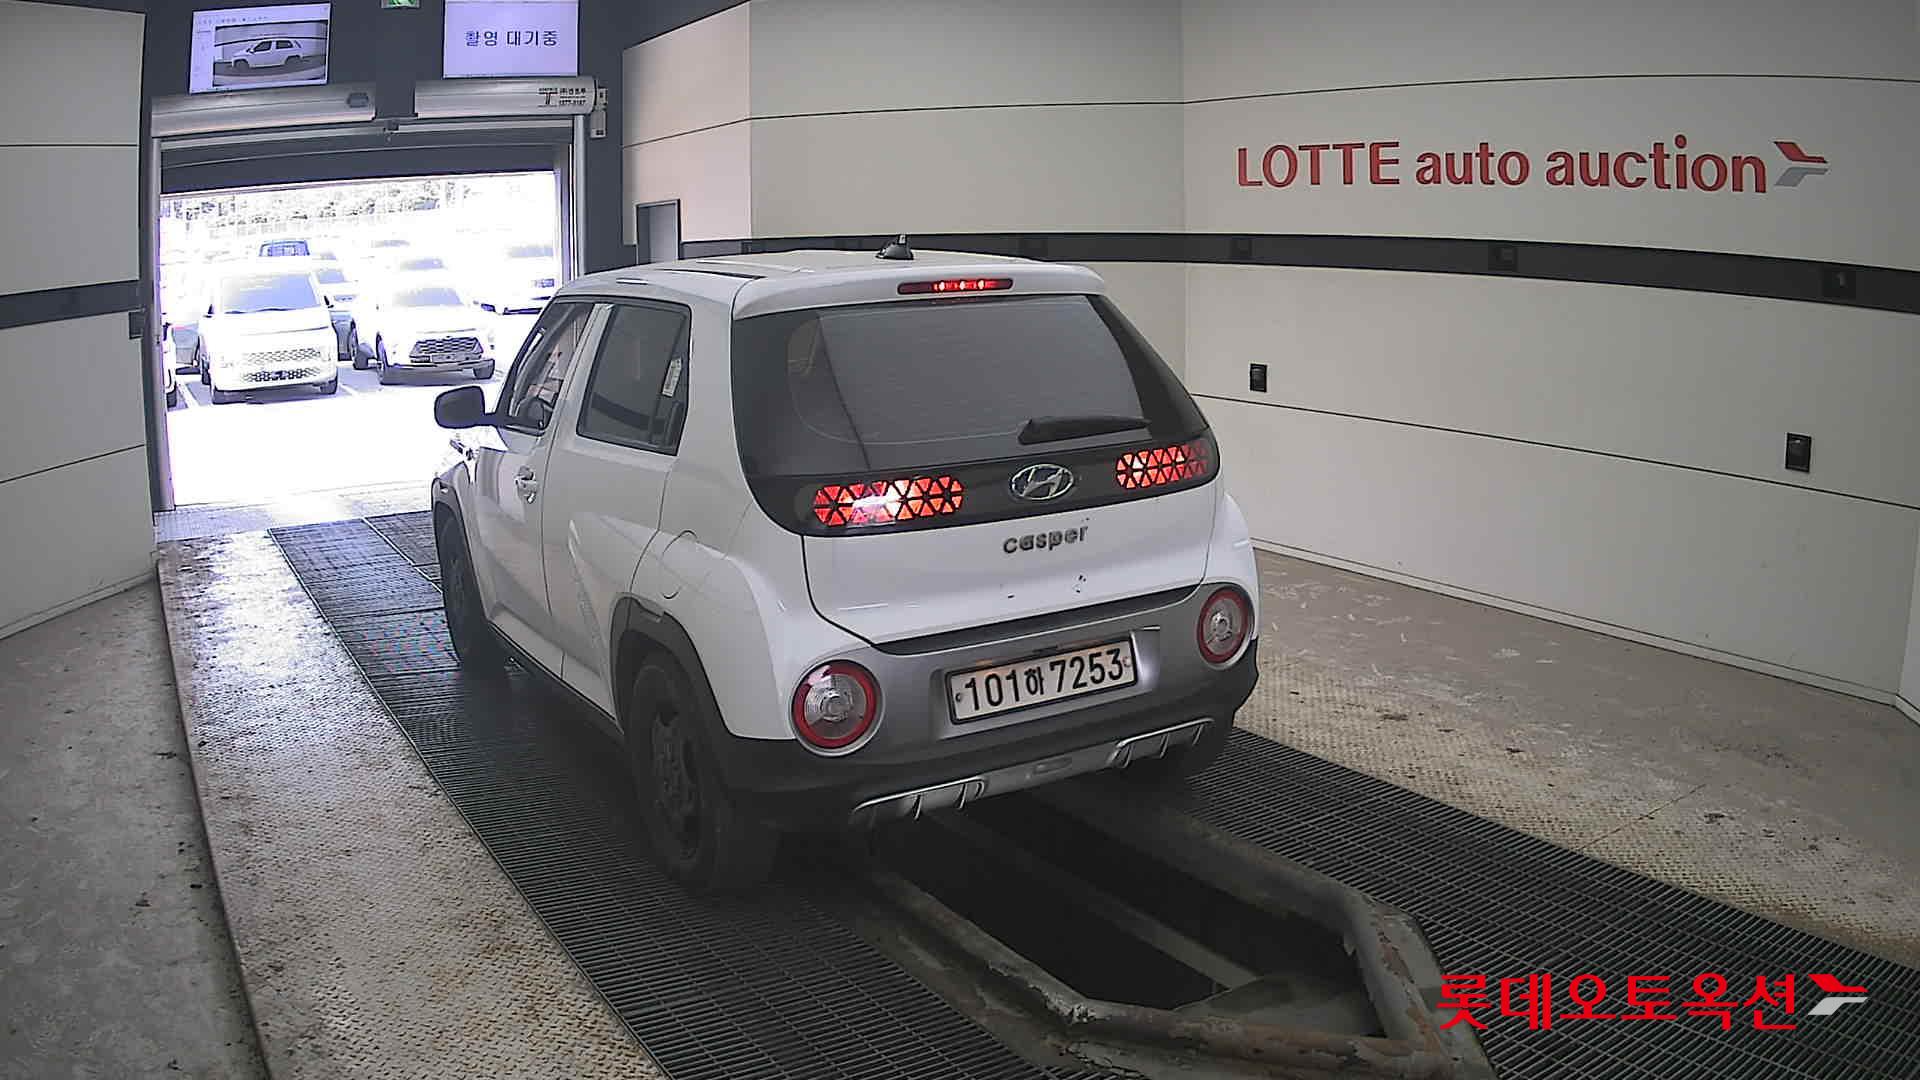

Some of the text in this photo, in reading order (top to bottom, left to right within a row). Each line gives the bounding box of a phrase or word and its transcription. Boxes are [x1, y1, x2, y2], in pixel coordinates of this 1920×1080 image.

[465, 30, 558, 46] 촬영 대기중
[1237, 135, 1767, 193] LOTTE auto auction
[1003, 526, 1089, 554] casper
